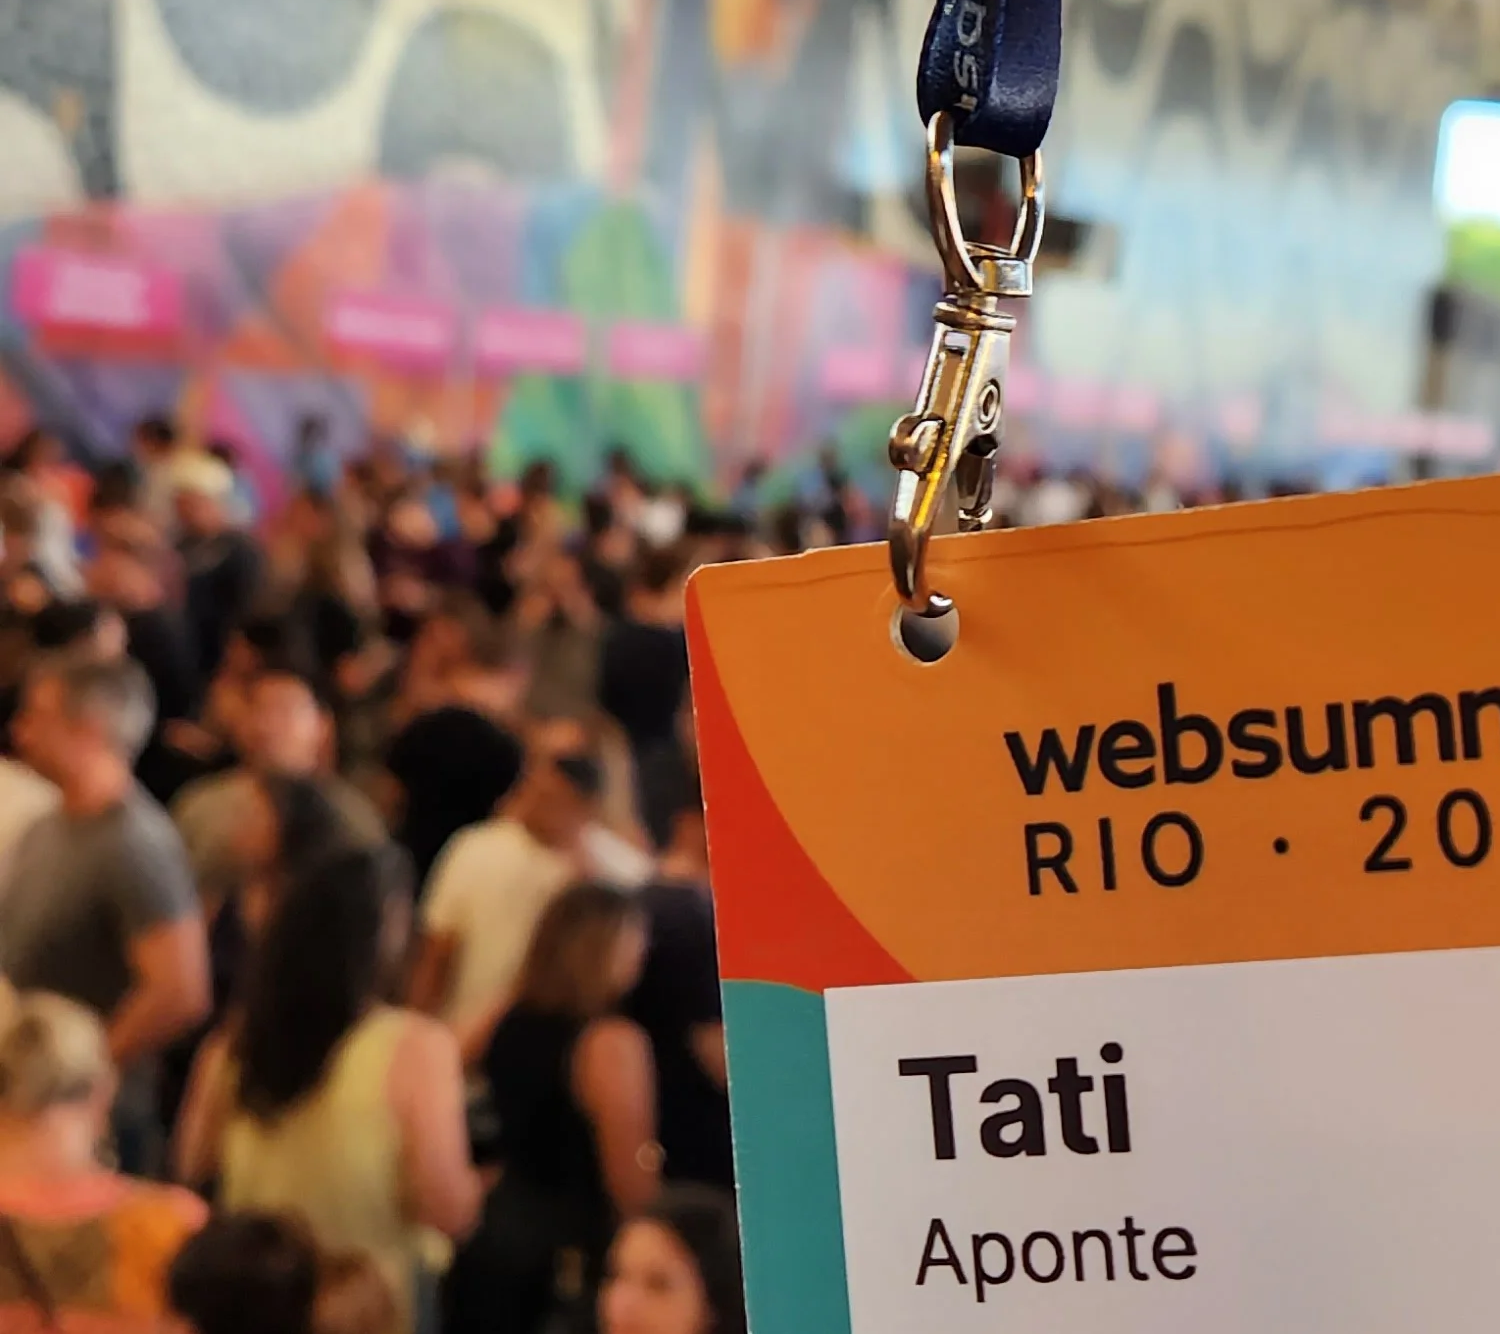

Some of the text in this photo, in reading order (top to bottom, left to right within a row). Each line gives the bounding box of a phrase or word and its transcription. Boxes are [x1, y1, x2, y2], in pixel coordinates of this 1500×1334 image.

[1023, 810, 1205, 896] RIO
[897, 1041, 1132, 1160] Tati
[915, 1215, 1198, 1303] Aponte
